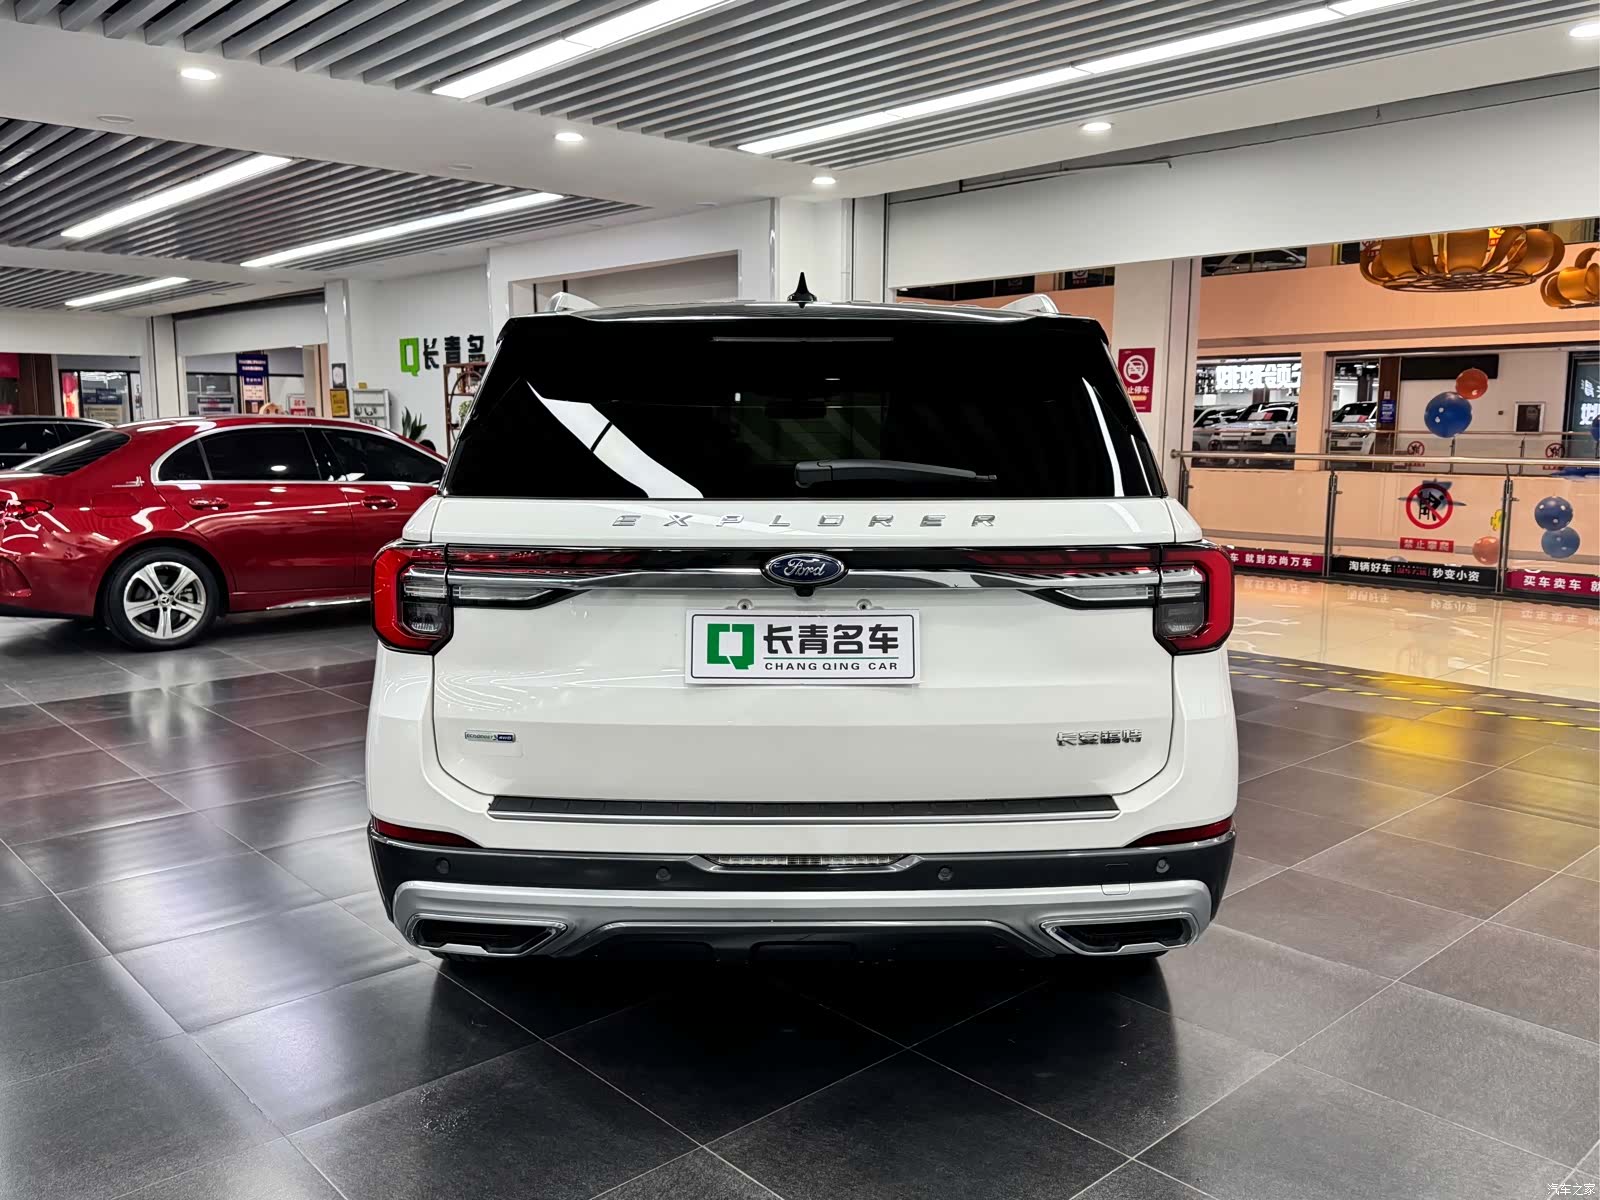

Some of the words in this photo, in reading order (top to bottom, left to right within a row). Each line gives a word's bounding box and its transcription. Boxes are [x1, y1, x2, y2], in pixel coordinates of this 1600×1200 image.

[612, 513, 998, 527] EXPLORER
[783, 558, 827, 577] Ford
[1245, 553, 1313, 568] 就到苏尚万车
[1348, 560, 1392, 574] 淘辆好车
[1432, 568, 1480, 582] 秒变小资
[1523, 575, 1582, 591] 买车卖车
[763, 624, 899, 655] 长青名车
[765, 662, 818, 670] CHANG
[822, 662, 860, 671] QING
[868, 662, 898, 670] CAR
